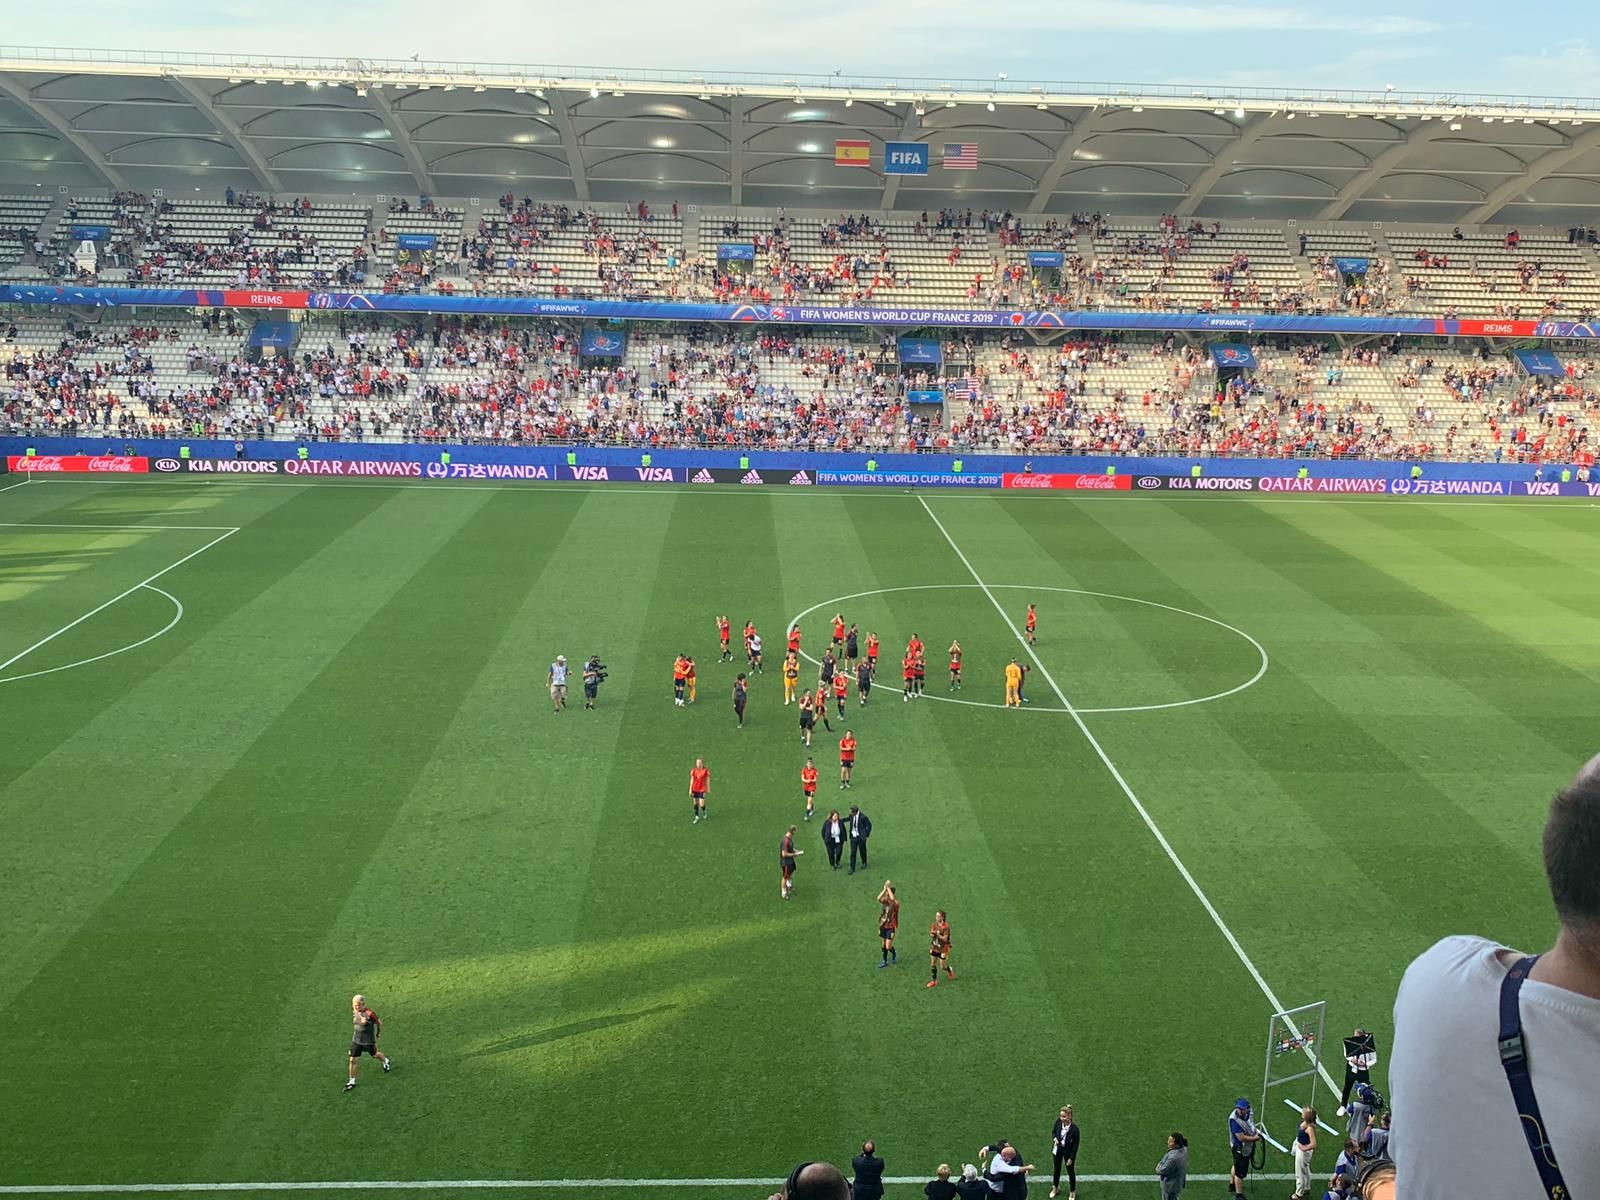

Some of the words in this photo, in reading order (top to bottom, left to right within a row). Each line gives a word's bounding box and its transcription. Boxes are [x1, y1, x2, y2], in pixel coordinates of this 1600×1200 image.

[891, 152, 922, 165] FIFA
[250, 294, 283, 305] REIMS
[540, 304, 580, 313] #FIFAWWC
[800, 310, 820, 319] FIFA
[822, 311, 870, 320] WOMEN'S
[871, 312, 908, 321] WORLD
[910, 312, 931, 321] CUP
[932, 313, 971, 322] FRANCE
[1210, 319, 1248, 327] #FIFAWWC
[1483, 323, 1513, 333] REIMS
[16, 456, 63, 472] Coca-Cola
[88, 456, 134, 472] Coca-Cola
[188, 460, 213, 472] KIA
[217, 460, 278, 473] MOTORS
[284, 459, 343, 475] QATAR
[347, 460, 422, 476] AIRWAYS
[569, 466, 609, 481] VISA
[635, 467, 674, 482] VISA
[819, 473, 838, 482] FIFA
[840, 473, 883, 483] WOMEN'S
[885, 474, 919, 483] WORLD
[920, 475, 940, 484] CUP
[941, 475, 976, 484] FRANCE
[1011, 474, 1053, 488] Coca-Cola
[1075, 475, 1117, 489] Coca-Cola
[1168, 477, 1192, 489] KIA
[1195, 477, 1253, 490] MOTORS
[1258, 477, 1313, 492] QATAR
[1317, 478, 1387, 492] AIRWAYS
[1524, 481, 1560, 495] VISA
[1585, 482, 1600, 496] VI
